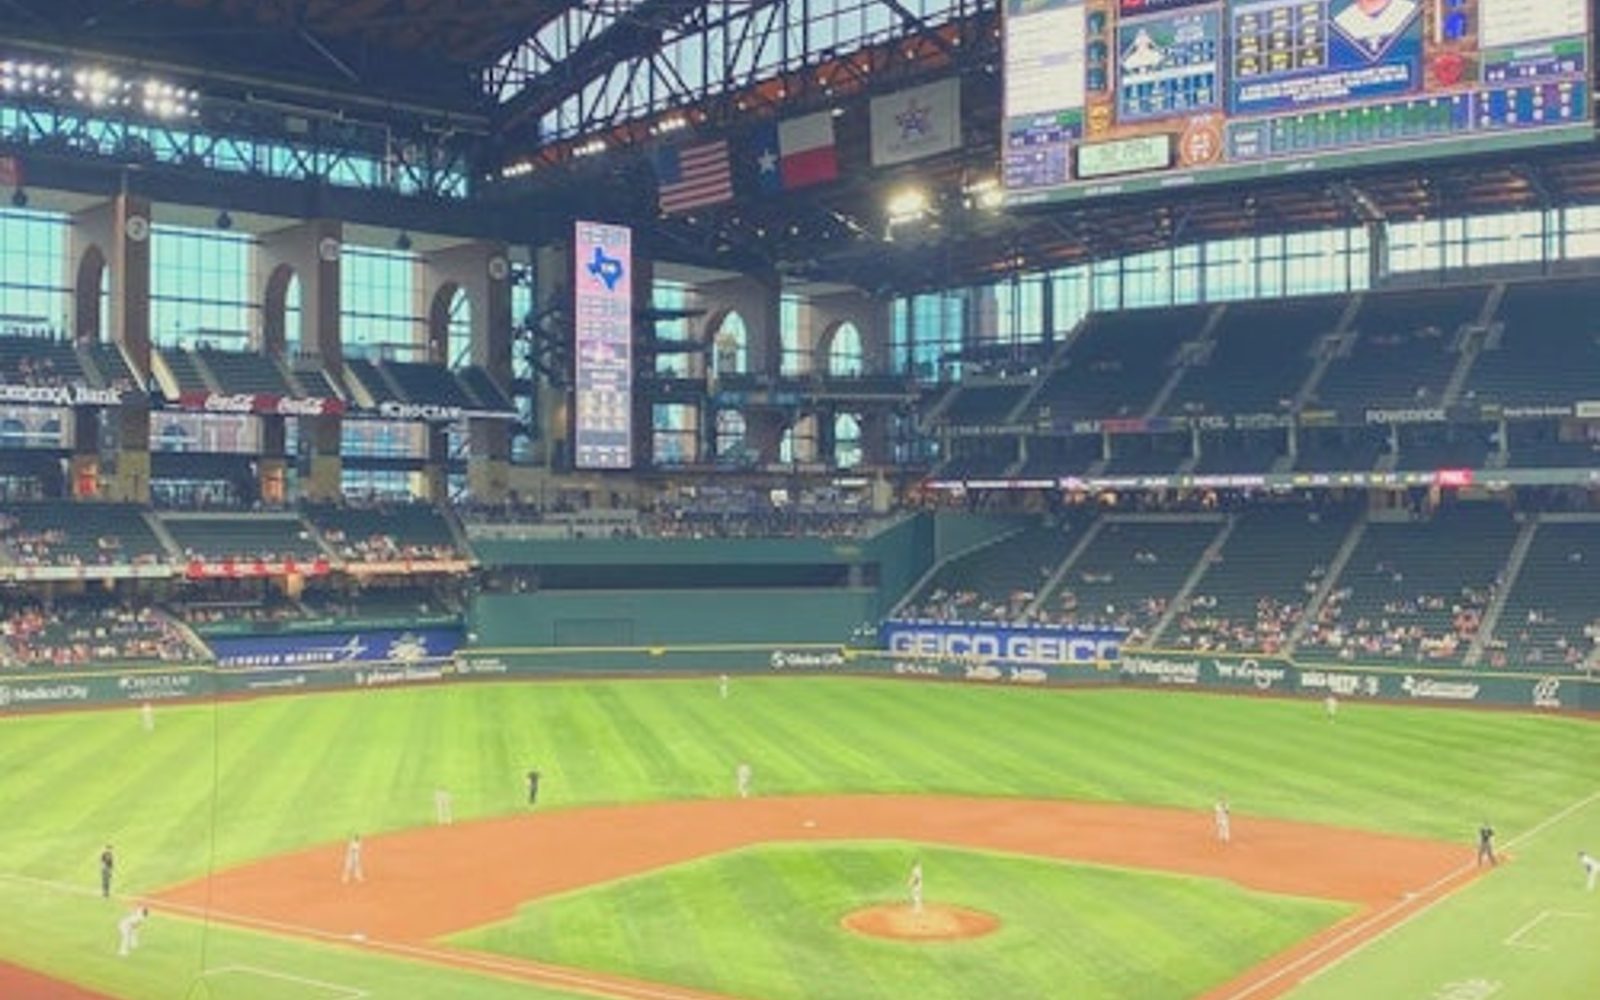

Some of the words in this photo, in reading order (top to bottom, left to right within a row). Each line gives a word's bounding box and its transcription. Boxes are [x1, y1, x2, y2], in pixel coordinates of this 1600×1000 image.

[1366, 408, 1447, 424] POWERADE
[890, 632, 998, 659] GEICO
[1007, 635, 1124, 664] GEICO
